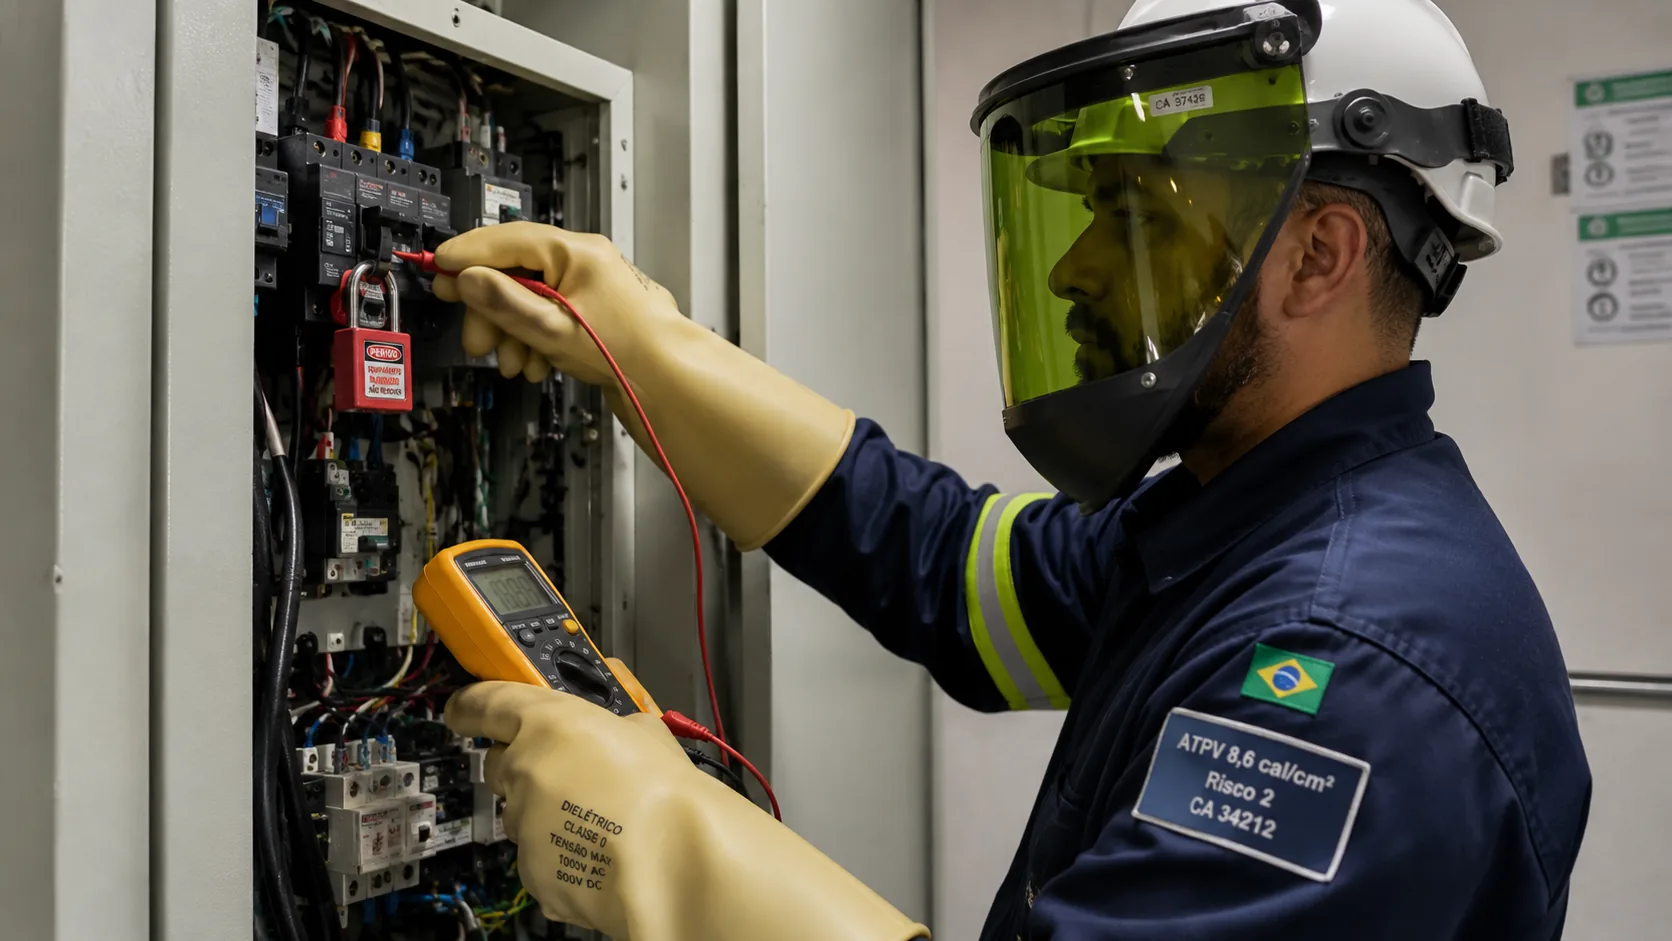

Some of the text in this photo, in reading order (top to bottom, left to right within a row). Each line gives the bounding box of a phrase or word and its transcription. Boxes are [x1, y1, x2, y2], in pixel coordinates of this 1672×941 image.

[1155, 97, 1171, 110] CA
[1176, 732, 1336, 793] ATPV 8,6 cal/cm²
[1204, 770, 1276, 808] Risco 2
[560, 799, 623, 836] DIELÉTRICO
[1189, 796, 1278, 840] CA 34212
[586, 879, 603, 891] DC
[590, 866, 606, 877] AC
